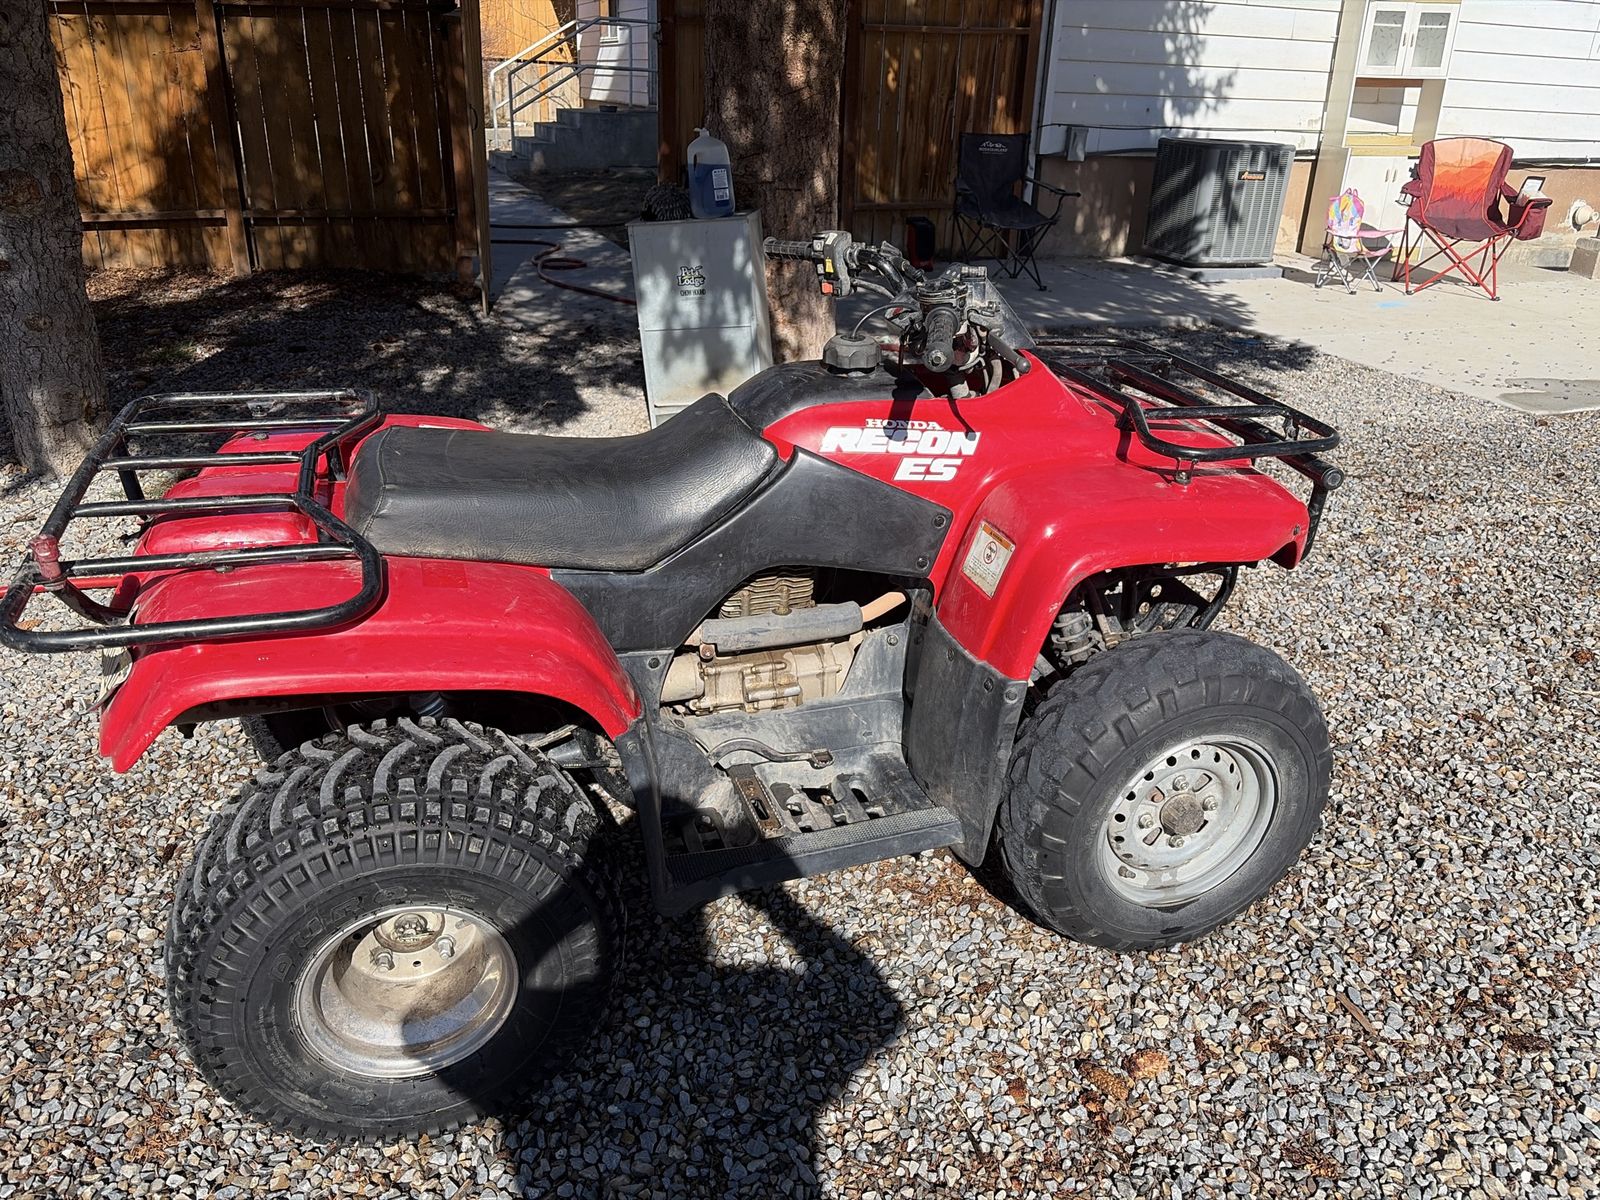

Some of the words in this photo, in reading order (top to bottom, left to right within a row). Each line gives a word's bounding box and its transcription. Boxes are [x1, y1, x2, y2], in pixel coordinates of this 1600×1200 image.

[681, 266, 695, 277] Pet
[678, 276, 704, 287] Lodge
[865, 418, 943, 430] HONDA
[819, 426, 981, 456] RECON
[893, 456, 963, 482] ES
